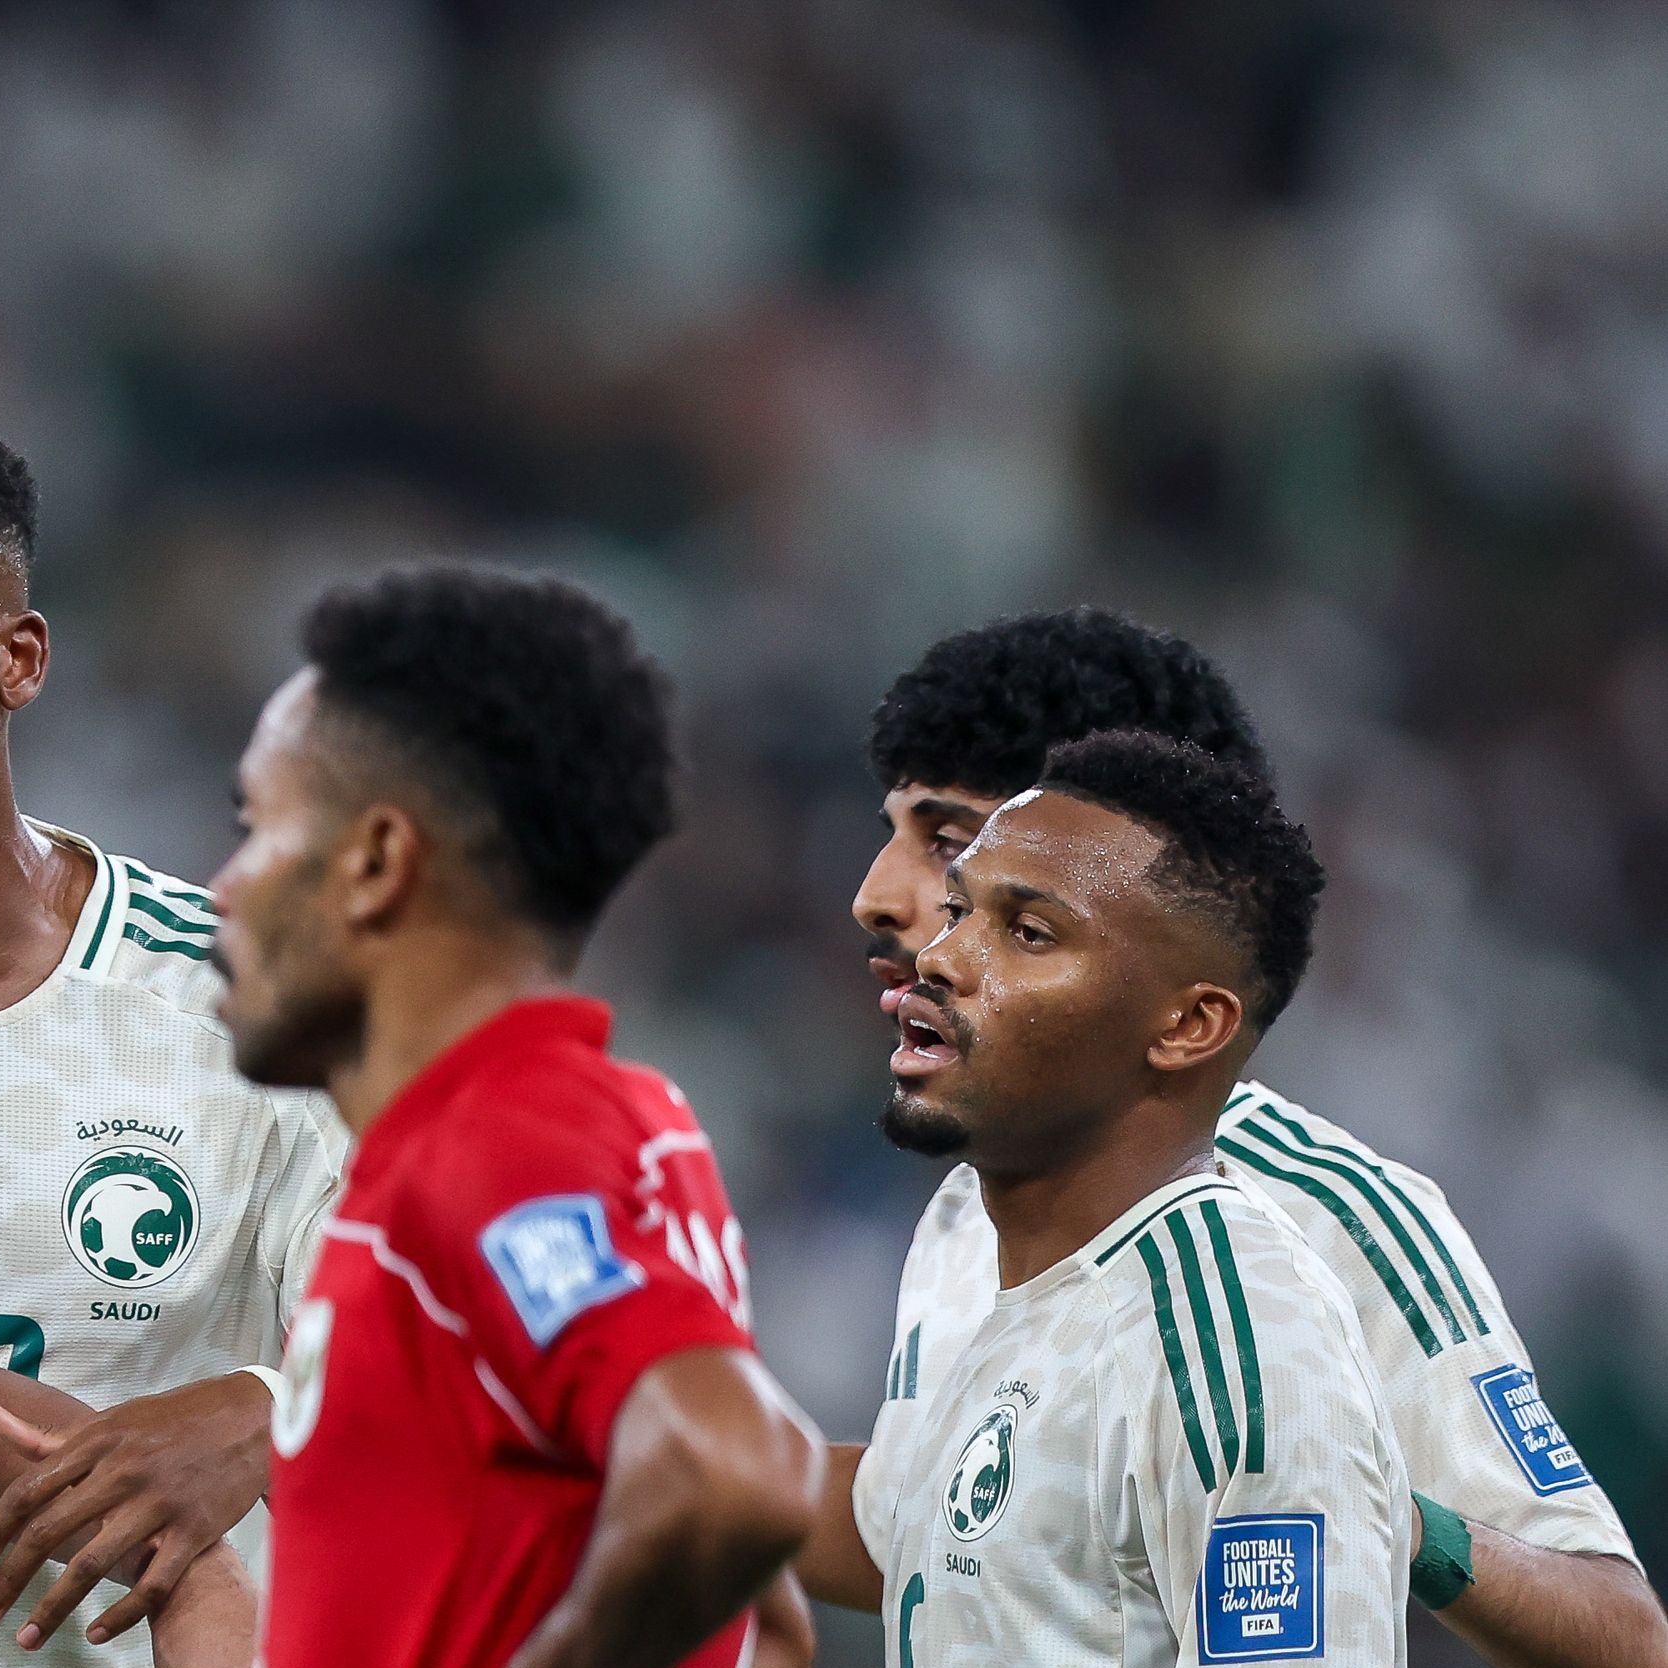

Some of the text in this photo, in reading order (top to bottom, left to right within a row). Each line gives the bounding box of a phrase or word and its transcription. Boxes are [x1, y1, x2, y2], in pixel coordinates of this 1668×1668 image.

[75, 1117, 185, 1148] السعودية
[135, 1232, 175, 1246] SAFF
[89, 1301, 162, 1321] SAUDI
[1554, 1451, 1577, 1464] FIF
[973, 1485, 995, 1502] SAFF
[1223, 1538, 1295, 1561] FOOTBALL
[946, 1553, 981, 1577] SAUDI
[1223, 1558, 1296, 1588] UNITES
[1219, 1584, 1301, 1613] the World
[1247, 1618, 1275, 1632] FIFA
